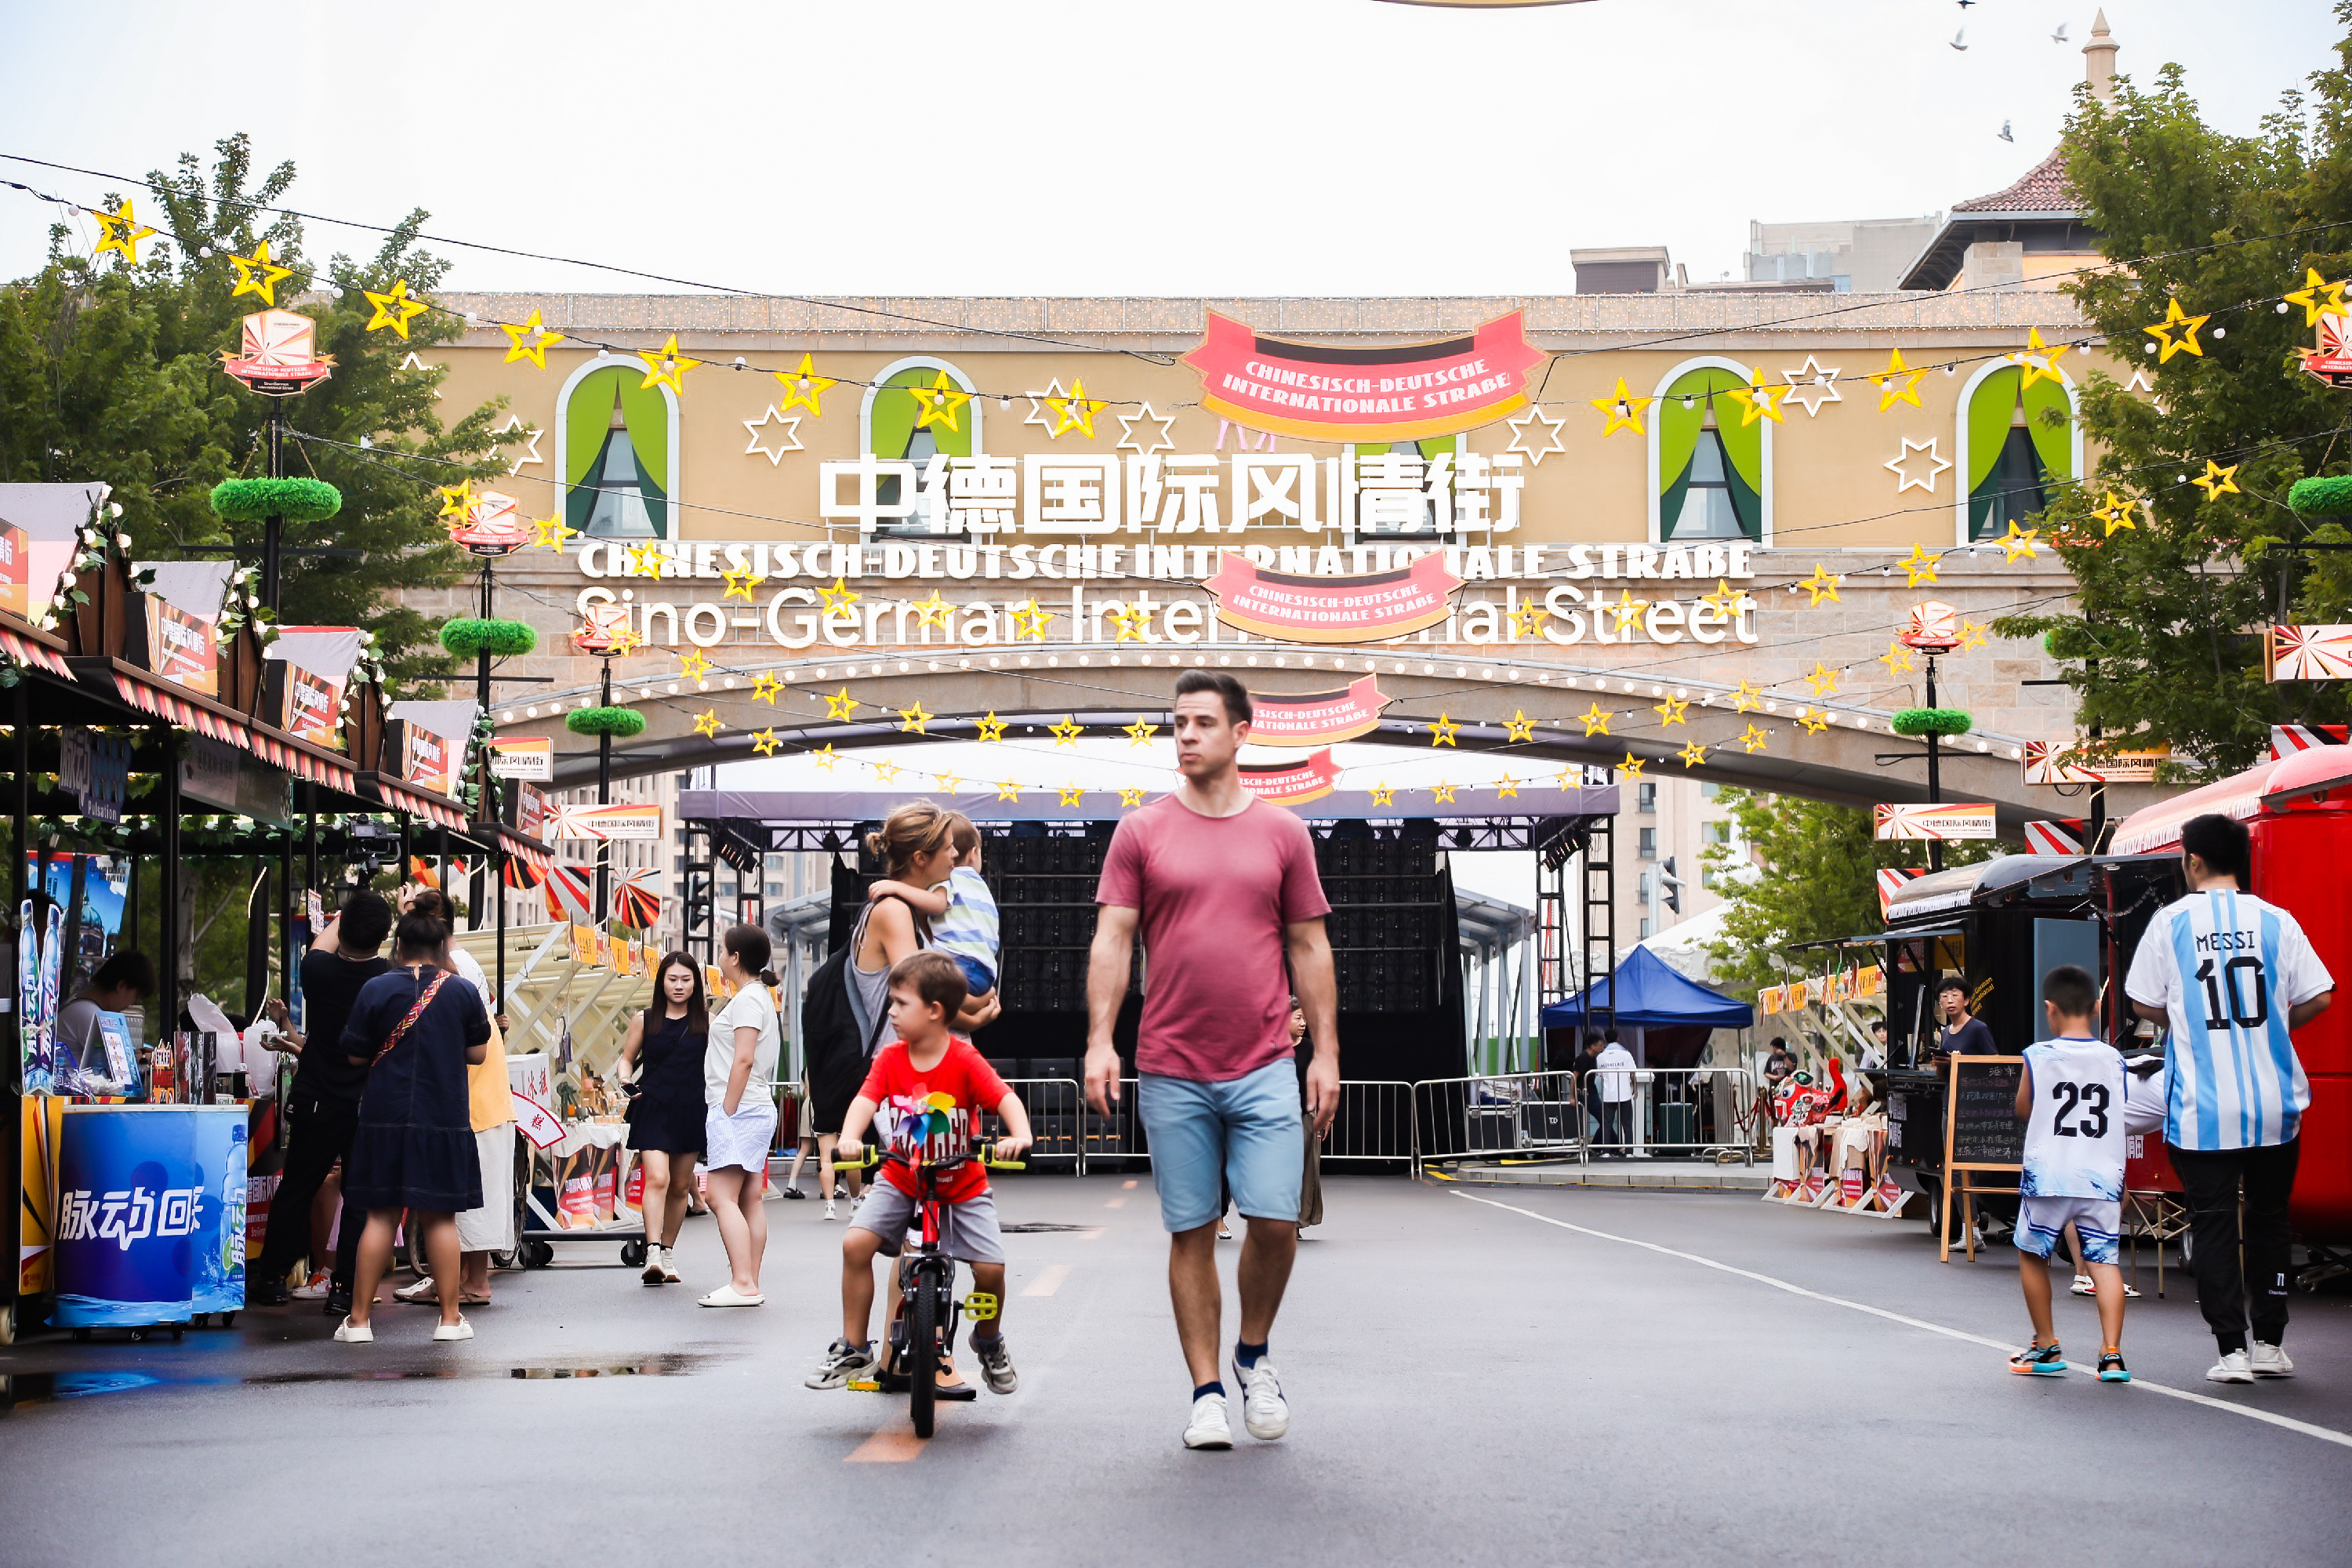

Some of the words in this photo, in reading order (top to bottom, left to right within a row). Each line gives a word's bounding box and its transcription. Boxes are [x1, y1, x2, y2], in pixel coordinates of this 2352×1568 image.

[241, 368, 289, 377] INTERNATIONALE
[1245, 358, 1490, 393] CHINESISCH-DEUTSCHE
[1222, 372, 1416, 413] INTERNATIONALE
[820, 453, 1525, 534] 中德国际风情街
[1232, 594, 1370, 622] INTERNATIONALE
[1249, 583, 1422, 608] CHINESISCH-DEUTSCHE
[1543, 585, 1759, 646] Street
[88, 800, 117, 821] Pulsation
[2196, 931, 2255, 952] MESSI
[2195, 956, 2268, 1030] 10
[2052, 1081, 2111, 1138] 23
